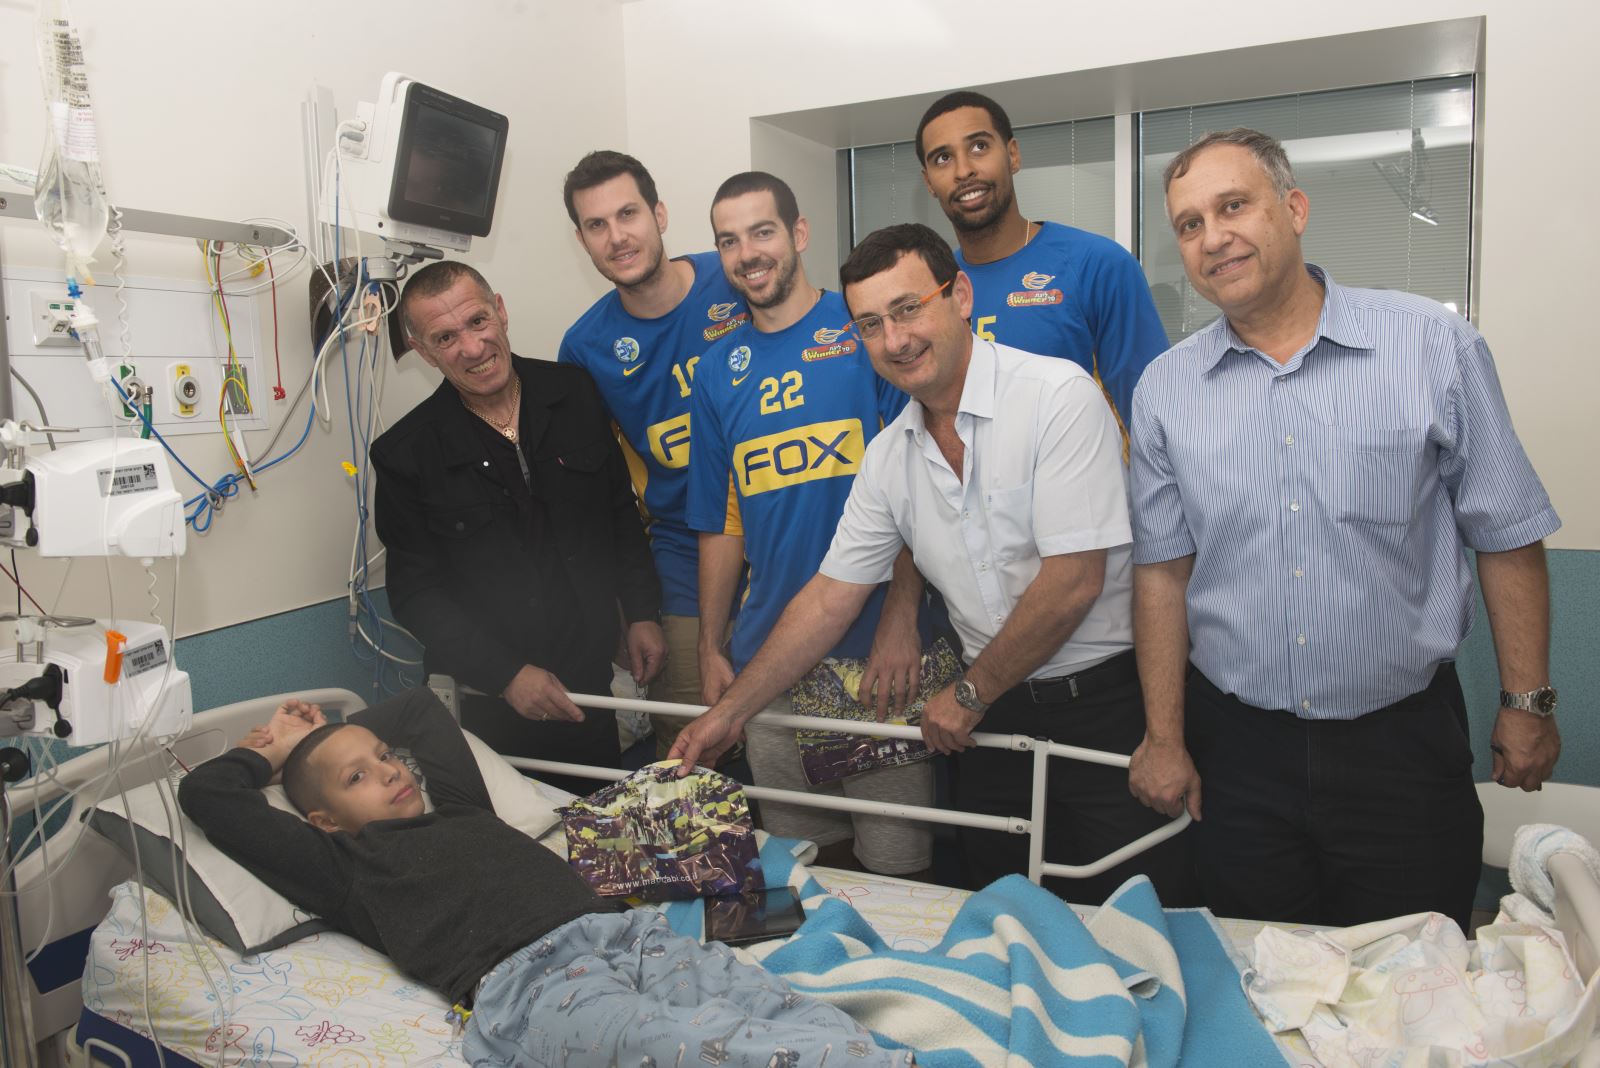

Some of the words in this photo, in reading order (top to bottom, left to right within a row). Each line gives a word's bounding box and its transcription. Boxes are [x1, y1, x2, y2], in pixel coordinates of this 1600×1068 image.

[1013, 295, 1047, 304] Winner
[708, 323, 738, 338] Winner
[971, 315, 997, 343] 5
[807, 349, 842, 360] Winner
[759, 370, 805, 415] 22
[743, 430, 853, 485] FOX
